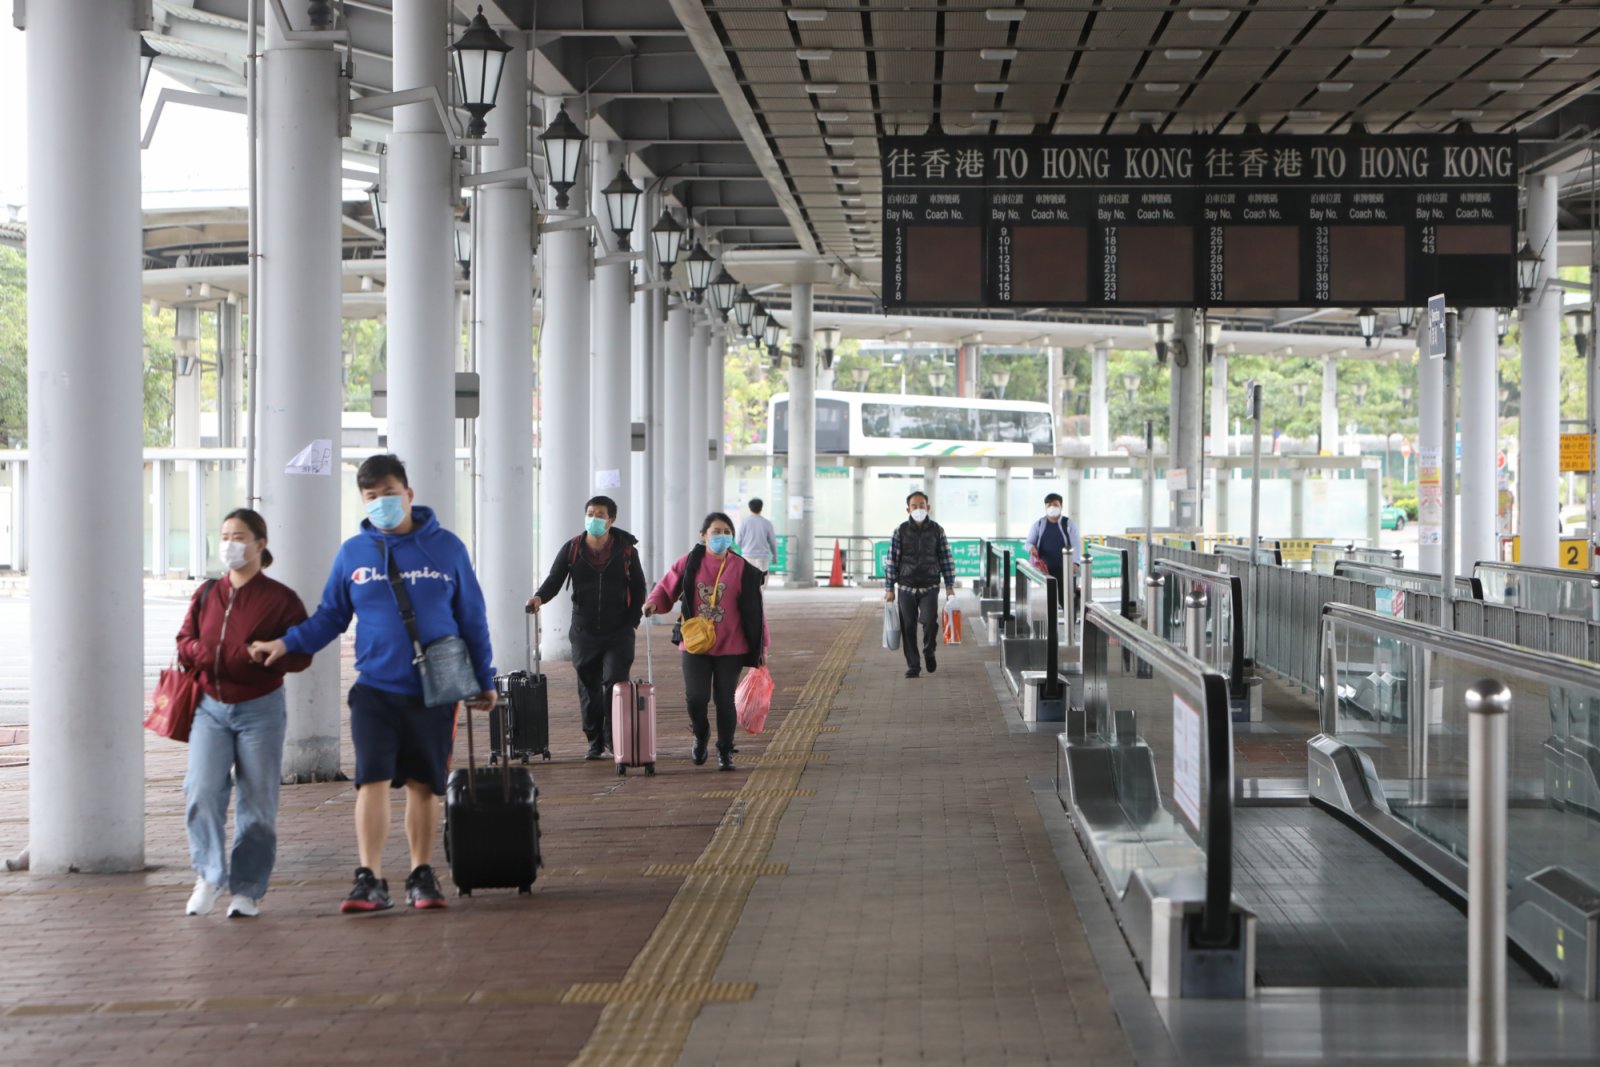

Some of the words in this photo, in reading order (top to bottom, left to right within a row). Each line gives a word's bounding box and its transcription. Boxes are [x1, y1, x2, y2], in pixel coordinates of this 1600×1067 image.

[888, 149, 984, 178] 往香港
[994, 149, 1028, 178] TO
[1042, 148, 1110, 178] HONG
[1125, 148, 1192, 178] KONG
[1206, 148, 1302, 178] 往香港
[1311, 148, 1346, 177] TO
[1360, 148, 1429, 177] HONG
[1443, 147, 1512, 177] KONG
[886, 209, 900, 221] Bay
[902, 209, 914, 220] No.
[926, 209, 948, 220] Coach
[951, 209, 963, 220] No.
[992, 209, 1006, 221] Bay
[1007, 209, 1020, 220] No.
[1031, 209, 1054, 220] Coach
[1056, 209, 1069, 220] No.
[1098, 209, 1112, 221] Bay
[1113, 209, 1126, 220] No.
[1137, 209, 1160, 220] Coach
[1162, 209, 1175, 220] No.
[1205, 208, 1218, 221] Bay
[1220, 208, 1232, 220] No.
[1244, 208, 1266, 220] Coach
[1269, 208, 1282, 220] No.
[1310, 208, 1323, 221] Bay
[1325, 208, 1338, 220] No.
[1349, 208, 1372, 220] Coach
[1374, 208, 1387, 220] No.
[1416, 208, 1430, 221] Bay
[1432, 208, 1444, 220] No.
[1455, 208, 1478, 220] Coach
[1481, 208, 1493, 220] No.
[896, 227, 901, 237] 1
[1000, 227, 1008, 237] 9
[1104, 227, 1116, 237] 17
[1210, 226, 1223, 235] 25
[1316, 226, 1328, 235] 33
[1422, 226, 1434, 235] 41
[896, 237, 902, 246] 2
[999, 237, 1010, 246] 10
[1104, 237, 1116, 246] 18
[1210, 235, 1223, 245] 26
[1316, 235, 1328, 245] 34
[1422, 235, 1435, 245] 42
[896, 246, 902, 255] 3
[999, 246, 1009, 255] 11
[1104, 246, 1116, 255] 19
[1210, 245, 1223, 254] 27
[1316, 245, 1328, 254] 35
[1422, 245, 1435, 254] 43
[896, 255, 902, 264] 4
[999, 255, 1010, 264] 12
[1104, 255, 1116, 264] 20
[1210, 254, 1223, 263] 28
[1316, 254, 1328, 263] 36
[896, 264, 902, 274] 5
[999, 264, 1010, 274] 13
[1104, 264, 1116, 274] 21
[1210, 263, 1223, 272] 29
[1316, 263, 1328, 272] 37
[896, 274, 902, 283] 6
[999, 274, 1010, 283] 14
[1104, 274, 1116, 283] 22
[1210, 272, 1223, 282] 30
[1316, 272, 1328, 282] 38
[896, 283, 902, 292] 7
[999, 283, 1010, 292] 15
[1104, 283, 1116, 292] 23
[1210, 282, 1222, 291] 31
[1316, 282, 1328, 291] 39
[896, 292, 902, 301] 8
[999, 292, 1010, 301] 16
[1104, 292, 1116, 301] 24
[1210, 291, 1223, 300] 32
[1316, 291, 1328, 300] 40
[1566, 546, 1578, 564] 2
[351, 566, 452, 585] Chmpion
